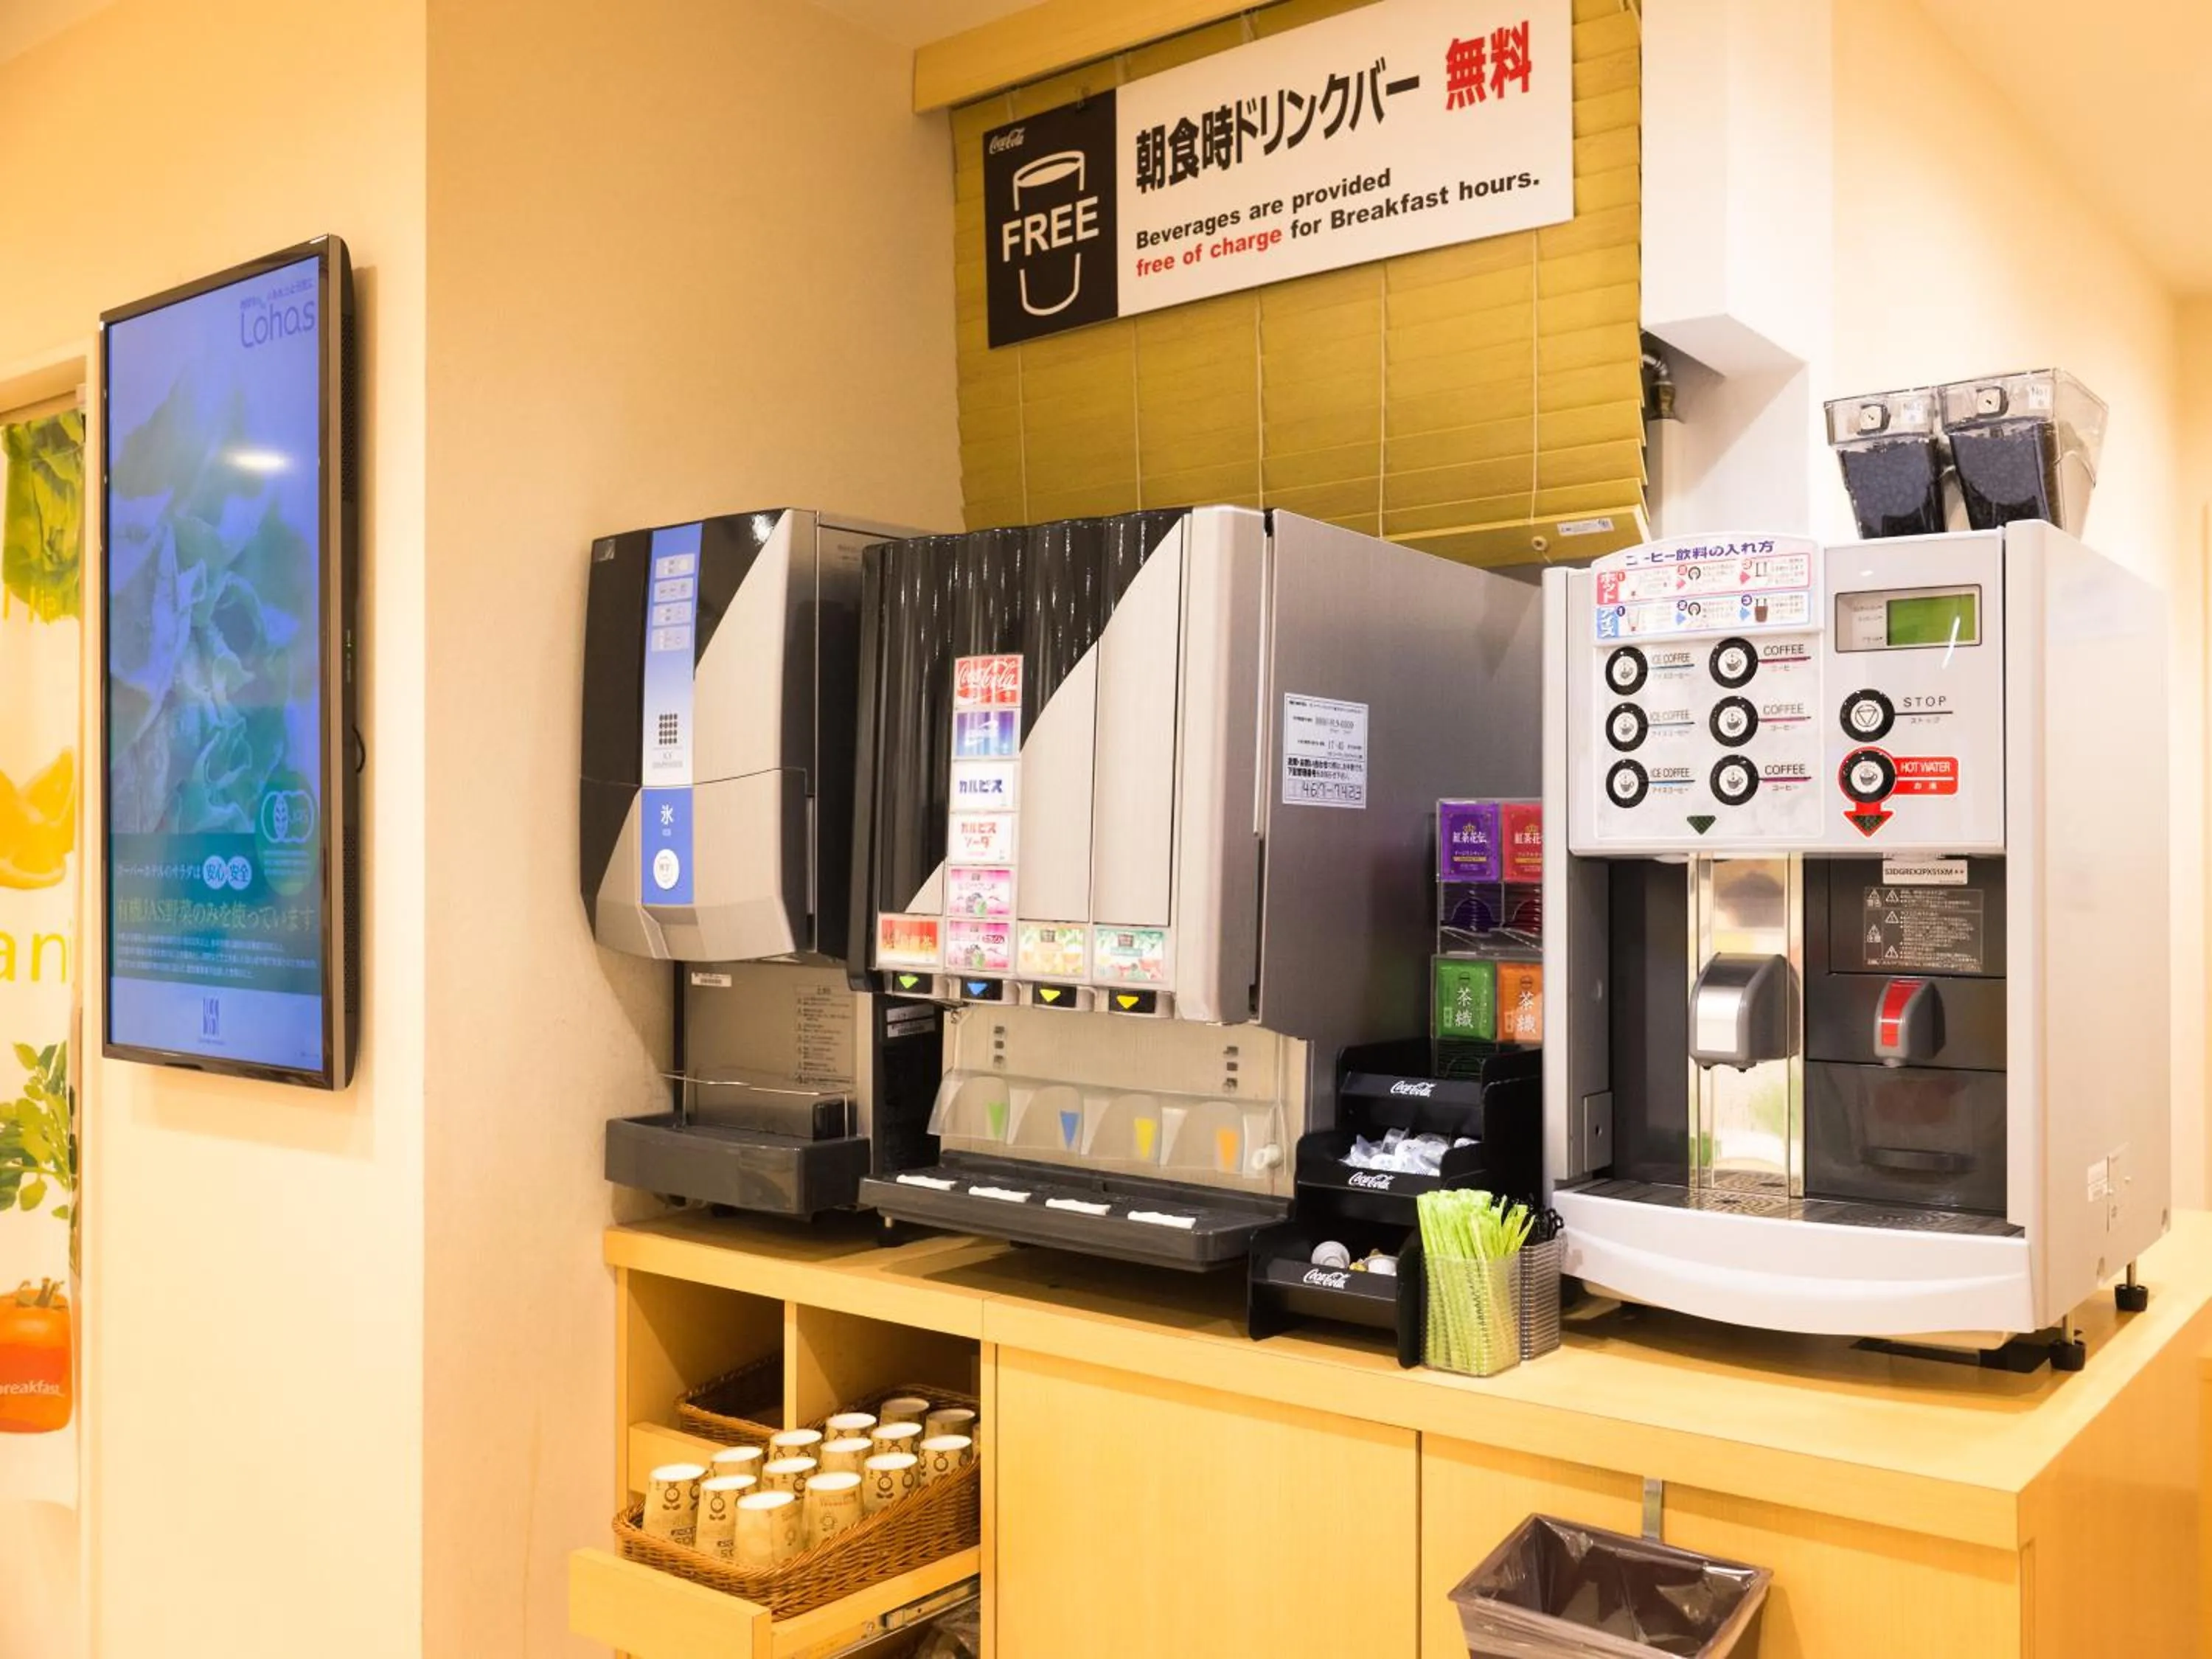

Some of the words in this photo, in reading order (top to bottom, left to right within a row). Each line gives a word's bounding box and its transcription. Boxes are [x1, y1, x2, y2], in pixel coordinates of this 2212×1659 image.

[1136, 56, 1419, 193] 朝食時ドリンクバー
[1444, 21, 1531, 111] 無料
[1136, 207, 1240, 250] Beverages
[1249, 196, 1283, 218] are
[1291, 167, 1391, 214] provided
[1003, 195, 1099, 262] FREE
[1136, 253, 1175, 278] free
[1183, 243, 1202, 265] of
[1210, 226, 1283, 262] charge
[1290, 218, 1321, 240] for
[1330, 185, 1449, 230] Breakfast
[1458, 170, 1540, 201] hours.
[241, 300, 316, 349] Lohas
[1763, 644, 1805, 656] COFFEE
[1663, 652, 1691, 664] COFFEE
[1763, 703, 1805, 715] COFFEE
[1903, 696, 1947, 708] STOP
[1663, 709, 1690, 722] COFFEE
[1663, 767, 1690, 779] COFFEE
[1764, 763, 1806, 775] COFFEE
[1901, 762, 1919, 773] HOT
[1920, 762, 1950, 773] WATER
[959, 779, 1003, 793] カルピス
[661, 804, 674, 825] 氷
[961, 822, 997, 835] カルピス
[964, 835, 992, 849] ソーダ
[1514, 832, 1543, 845] 紅茶花
[1390, 1080, 1437, 1098] Coca-Cola
[1348, 1172, 1395, 1191] Coca-Cola
[1303, 1269, 1352, 1290] Coca-Cola
